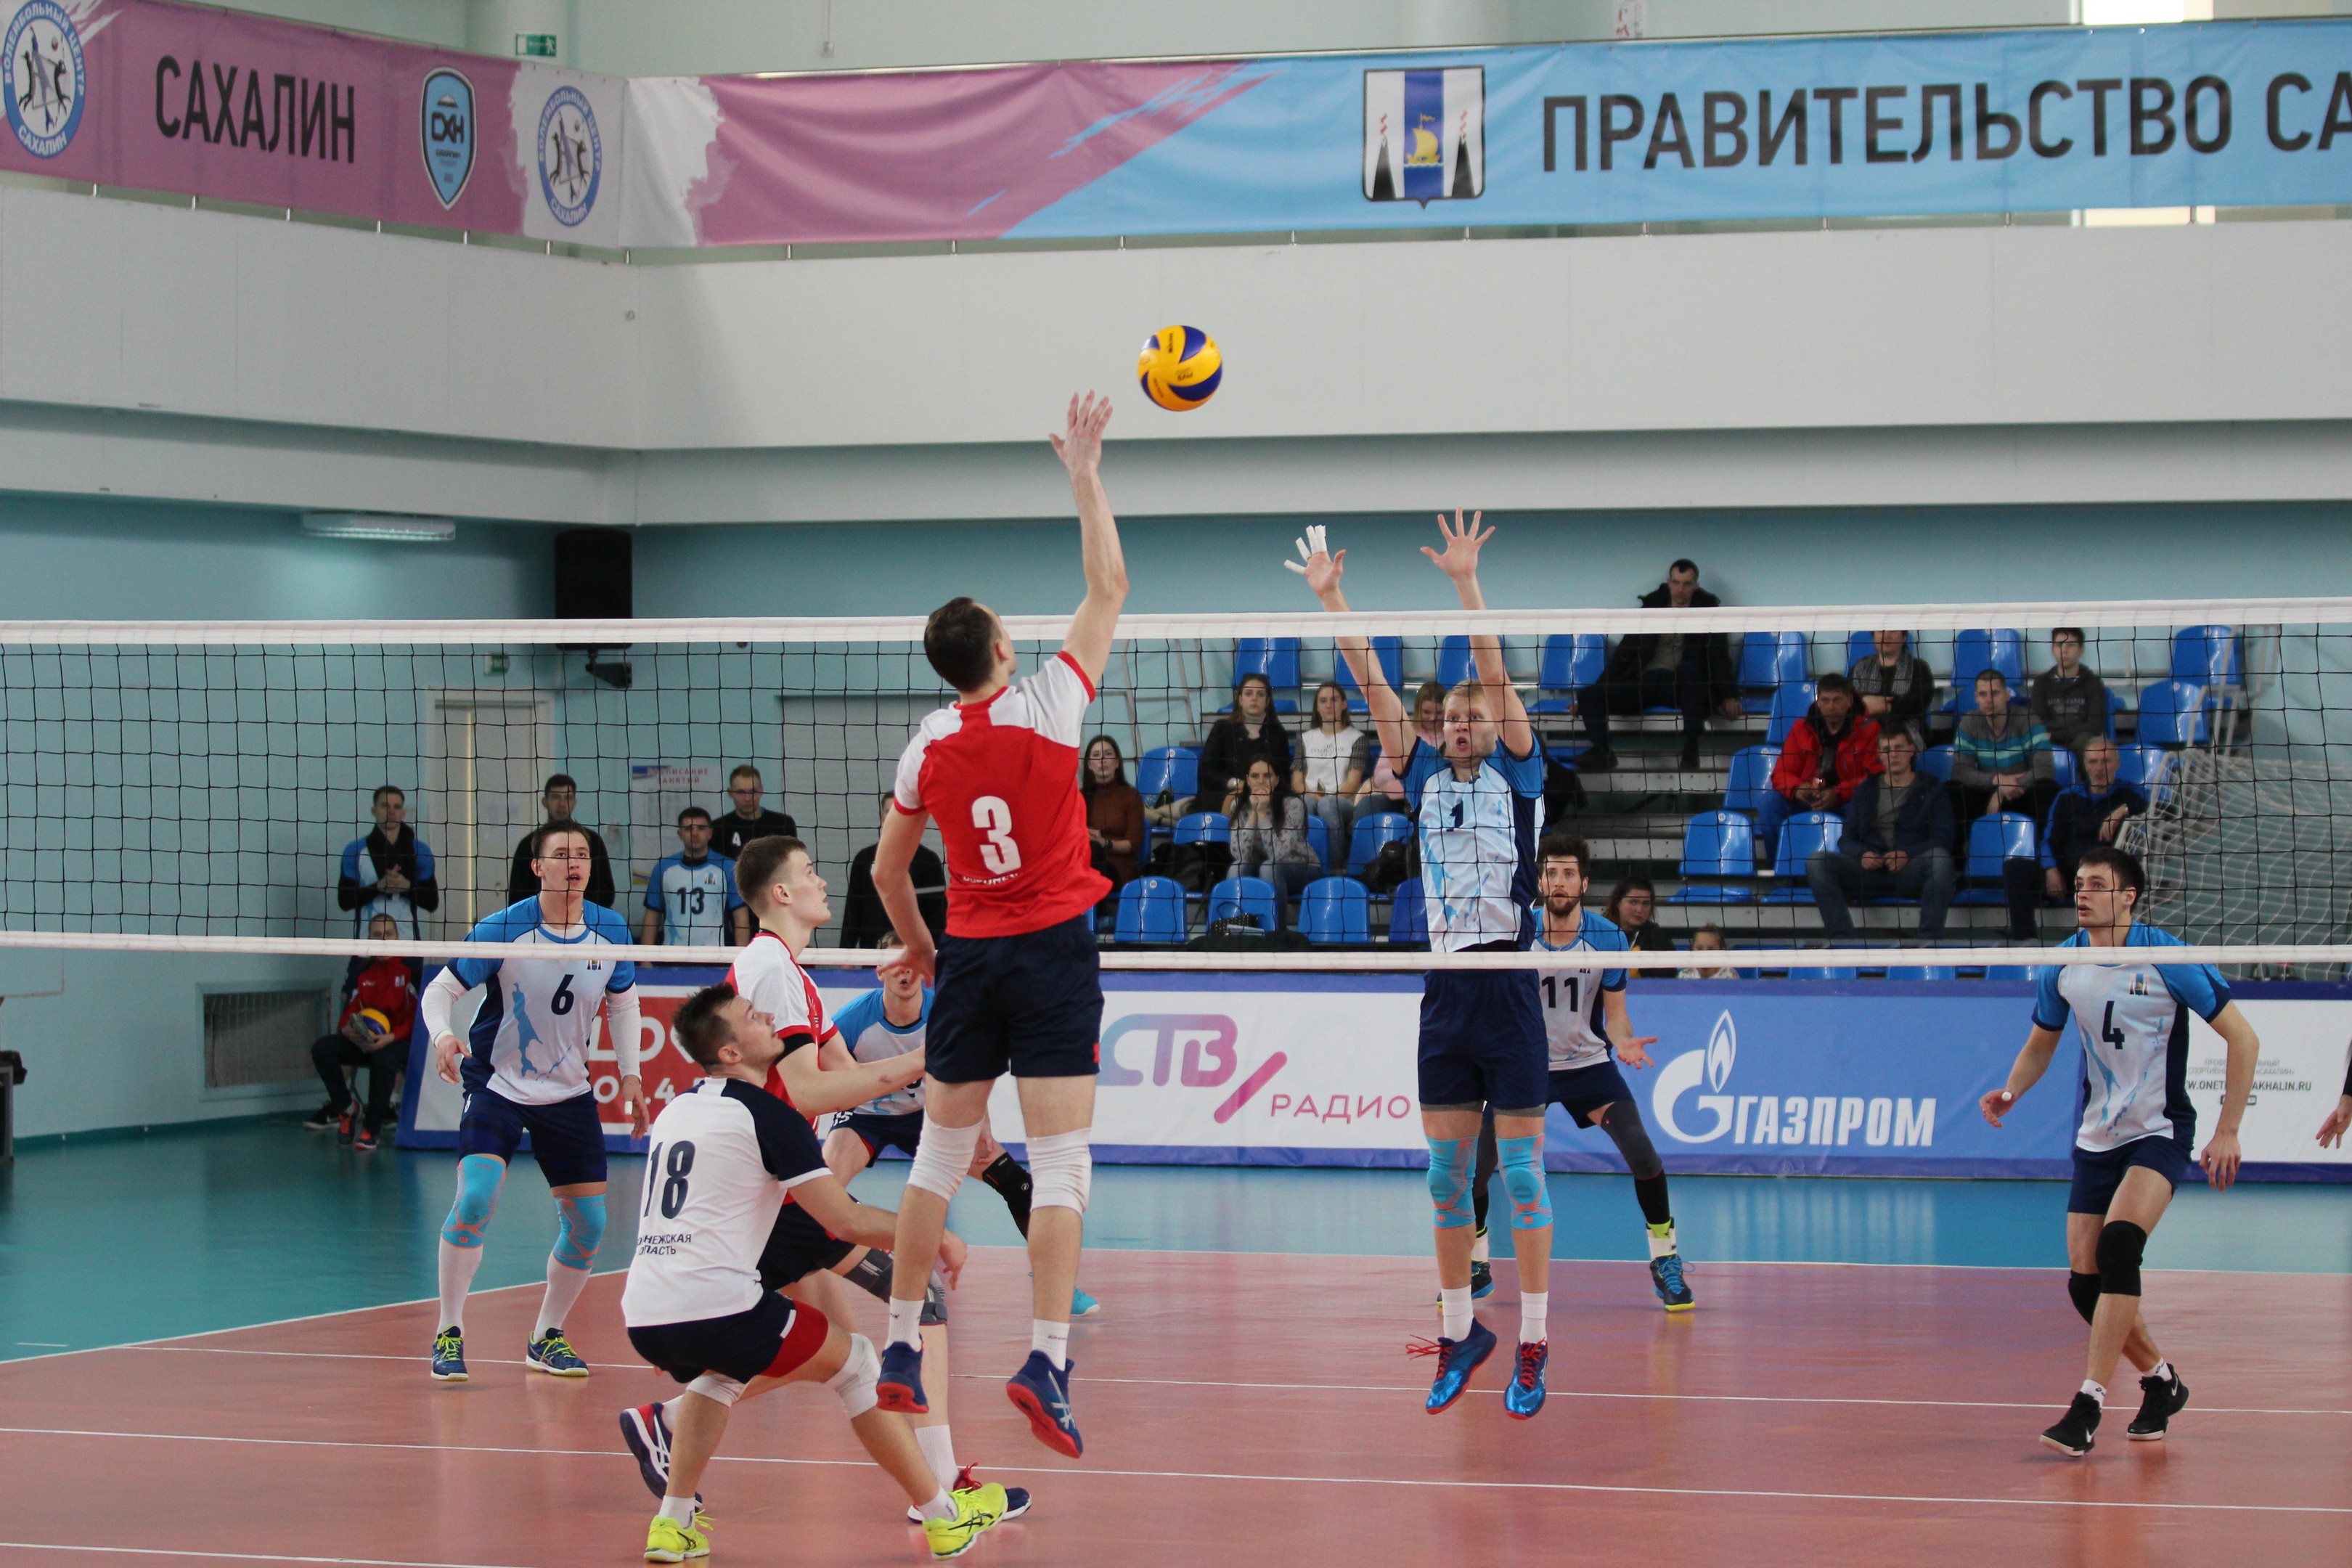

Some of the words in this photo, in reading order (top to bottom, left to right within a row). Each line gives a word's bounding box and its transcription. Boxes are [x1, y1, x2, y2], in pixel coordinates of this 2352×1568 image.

[4, 3, 69, 84] ВОЛЕЙБОЛЬНЫЙ
[68, 32, 85, 97] ЦЕНТР
[156, 55, 355, 163] САХАЛИН
[1543, 75, 2232, 172] ПРАВИТЕЛЬСТВО
[2266, 72, 2352, 152] СА
[19, 125, 68, 155] САХАЛИН
[971, 795, 1022, 875] 3
[1446, 799, 1463, 832] 1
[677, 886, 705, 915] 13
[550, 973, 575, 1016] 6
[1541, 976, 1579, 1013] 11
[2102, 1000, 2126, 1050] 4
[1270, 1094, 1411, 1124] РАДИО
[1734, 1095, 1937, 1146] ГАЗПРОМ
[643, 1140, 696, 1220] 18
